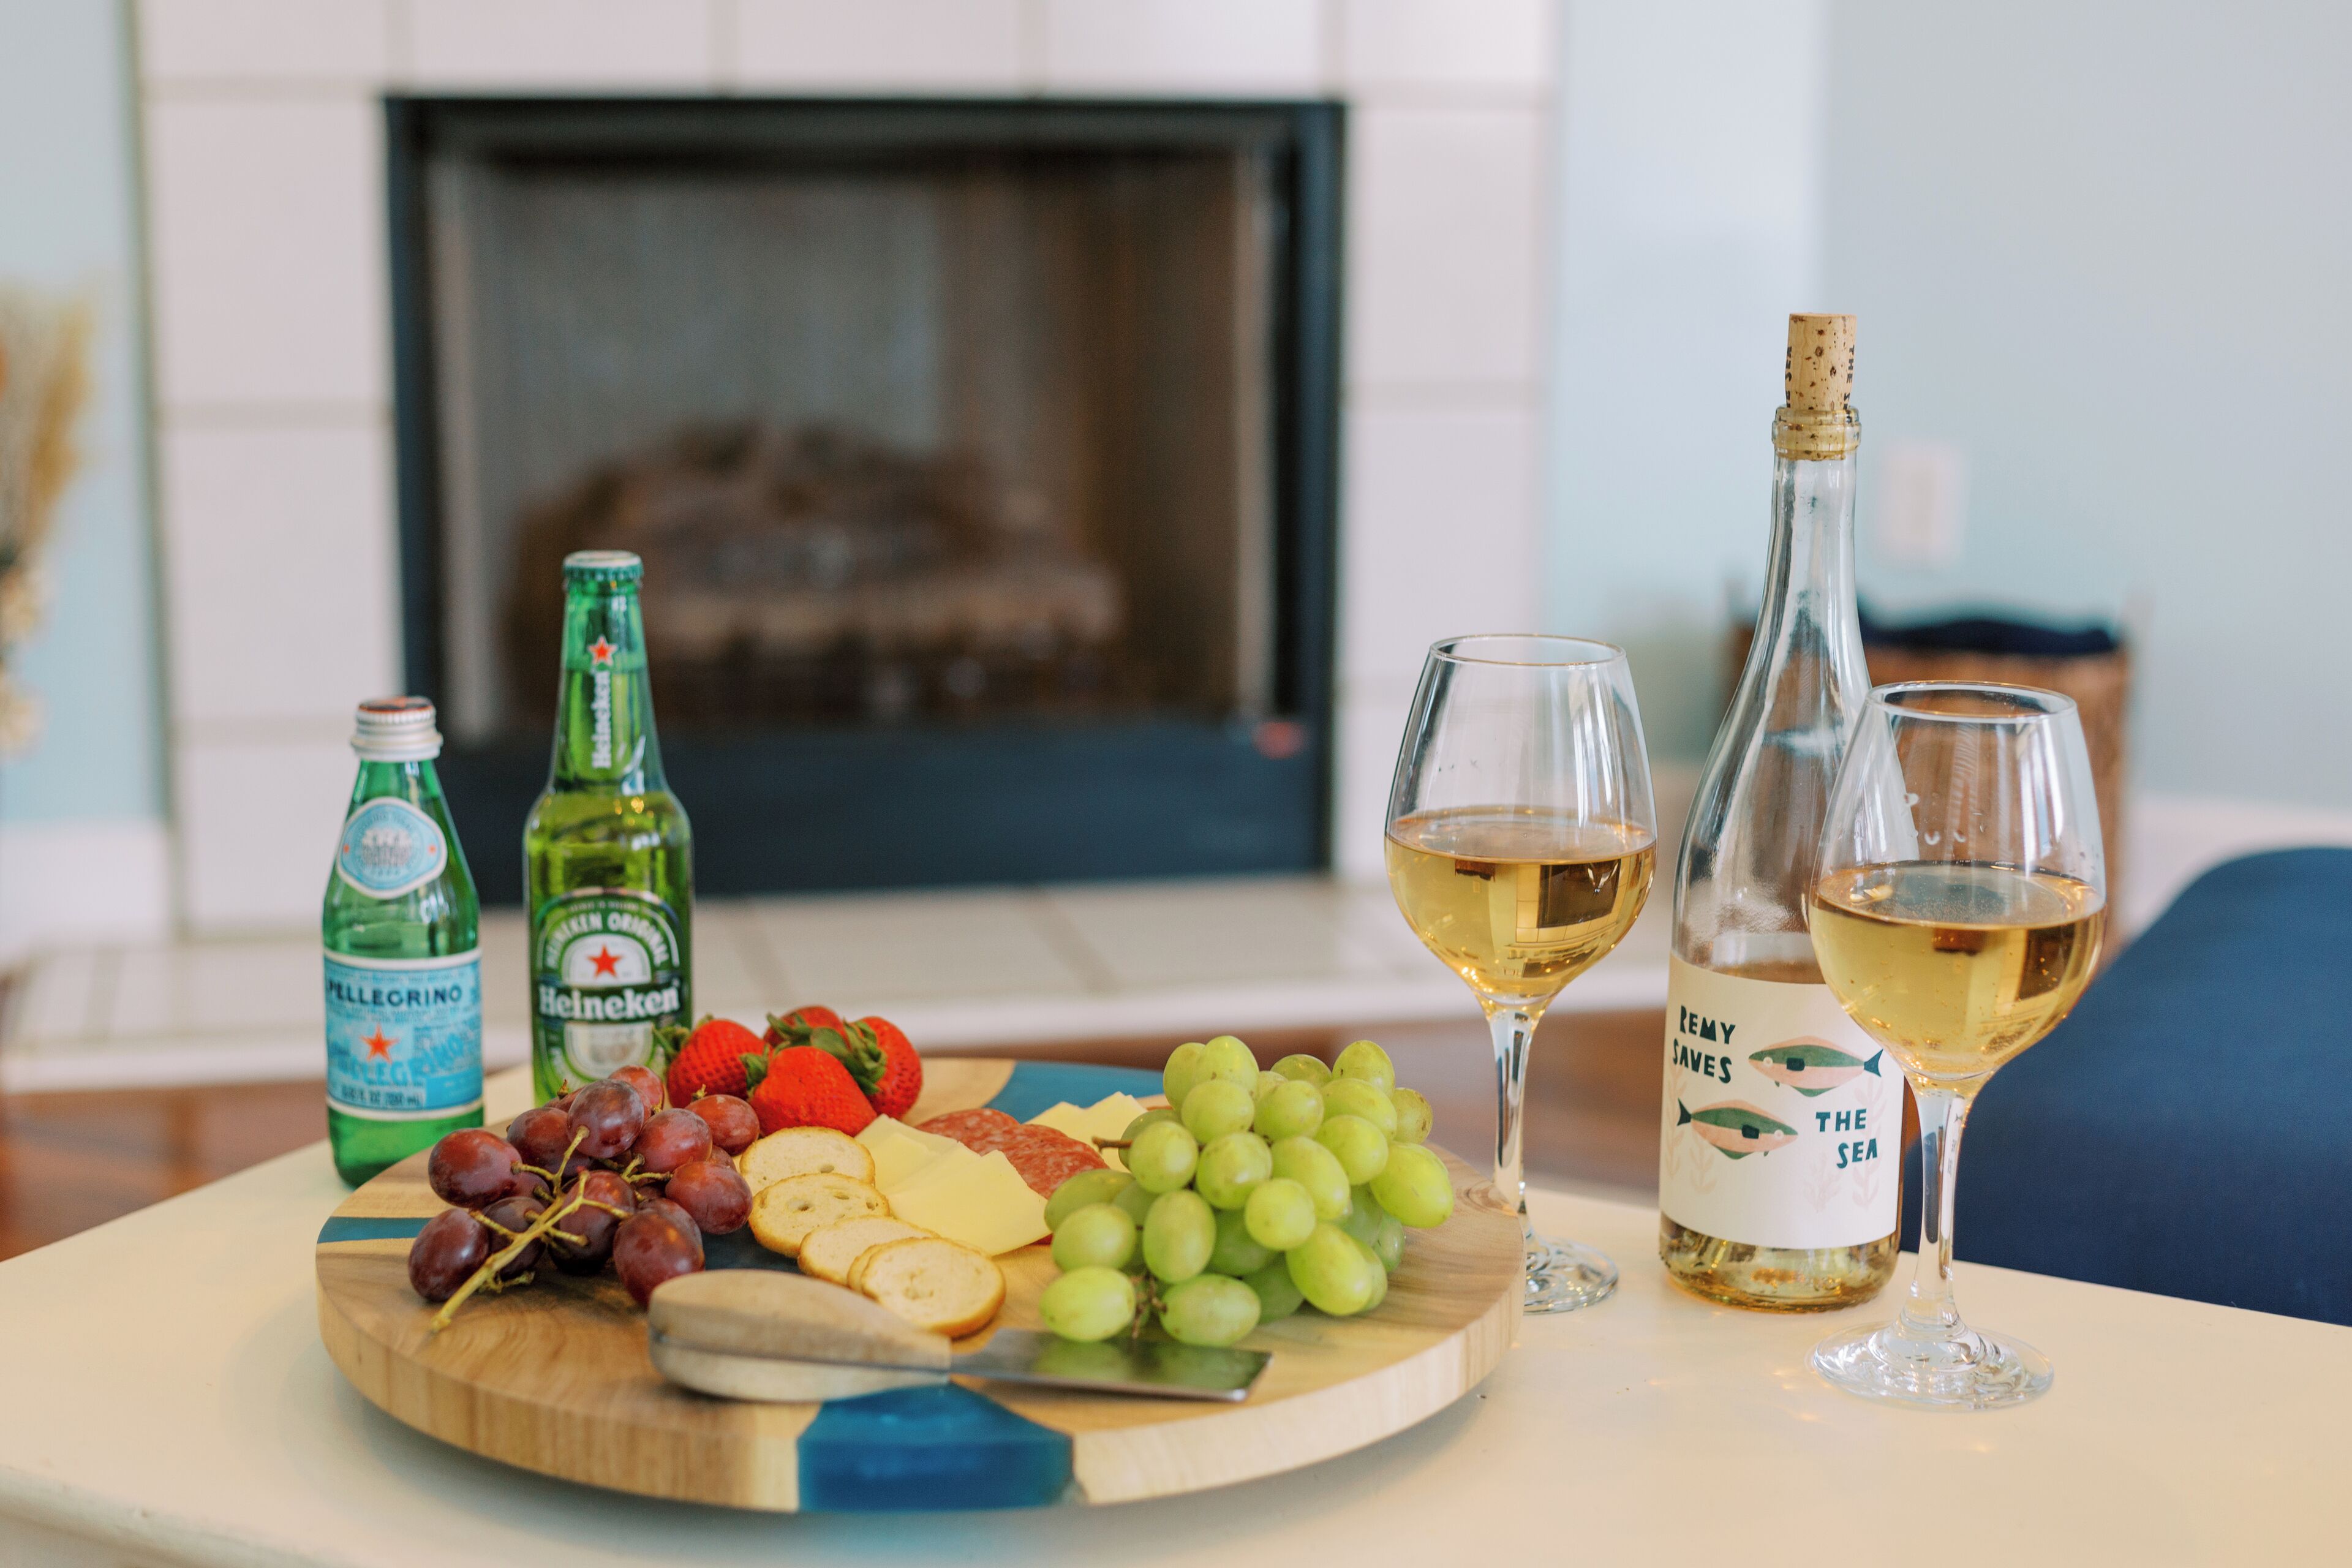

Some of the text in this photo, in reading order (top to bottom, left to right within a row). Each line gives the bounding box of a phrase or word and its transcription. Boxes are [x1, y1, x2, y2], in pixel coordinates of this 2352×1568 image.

[592, 671, 611, 768] Heineken
[328, 981, 462, 1006] PELLEGRINO
[540, 986, 680, 1020] Heineken
[1679, 1005, 1736, 1044] REMY
[1672, 1038, 1733, 1084] SAVES
[1815, 1109, 1867, 1132] THE
[1836, 1137, 1878, 1169] SEA
